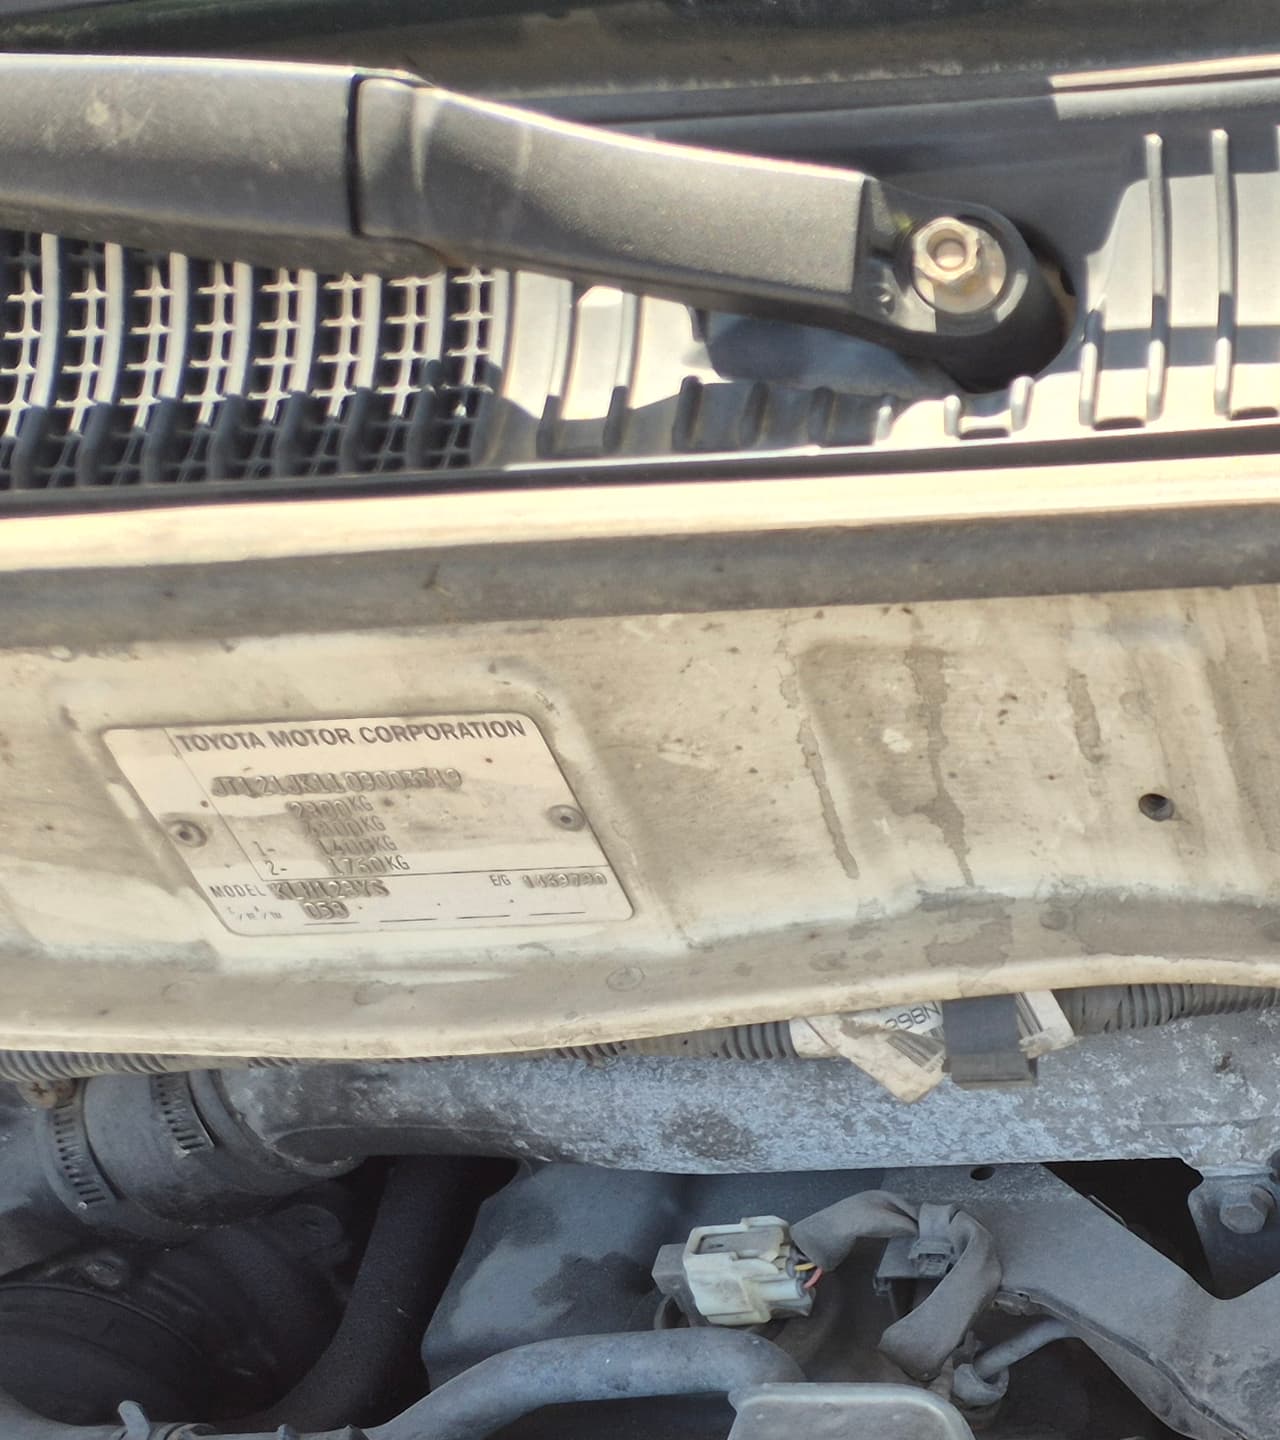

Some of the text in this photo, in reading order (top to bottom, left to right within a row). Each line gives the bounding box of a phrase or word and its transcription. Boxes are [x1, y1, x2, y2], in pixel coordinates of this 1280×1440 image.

[176, 720, 527, 752] TOYOTA MOTOR CORPORATION
[209, 883, 267, 898] MODEL
